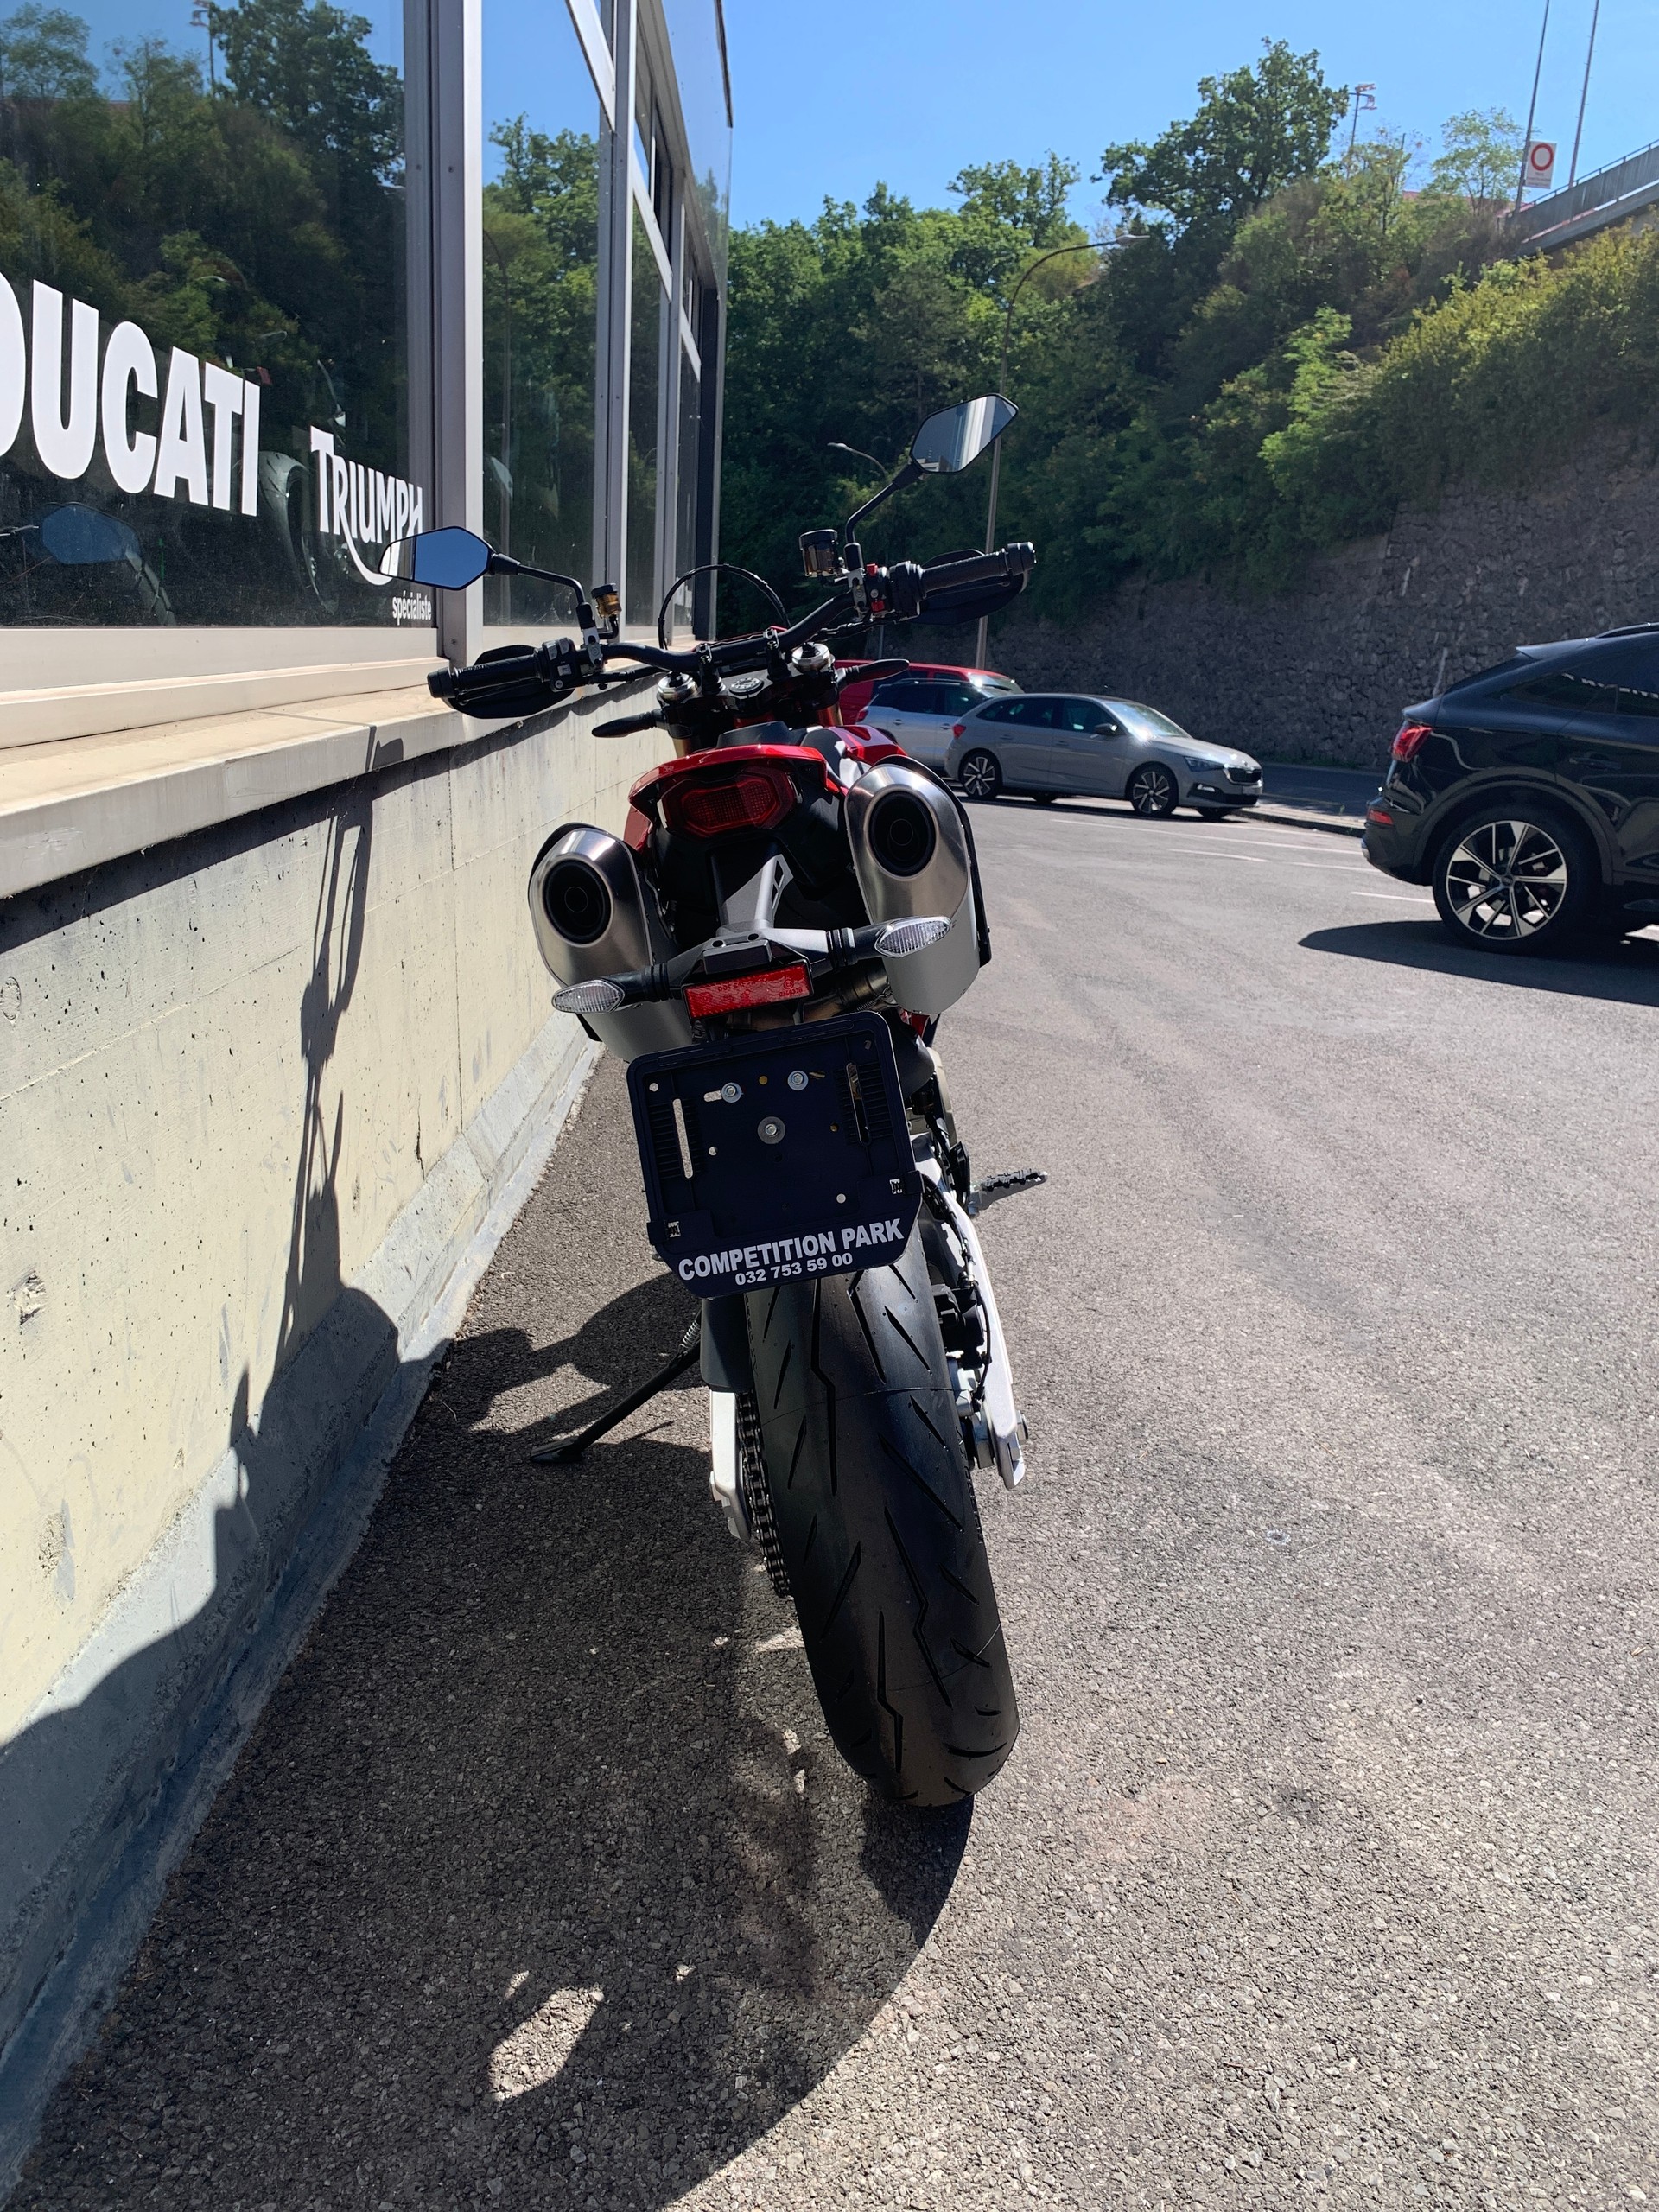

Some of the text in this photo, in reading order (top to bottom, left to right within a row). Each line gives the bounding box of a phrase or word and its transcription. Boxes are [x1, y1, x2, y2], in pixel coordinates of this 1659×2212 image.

[310, 425, 423, 585] TRIUMPH
[392, 590, 432, 626] spécialiste
[678, 1217, 905, 1281] COMPETITION PARK
[735, 1252, 854, 1286] 032 753 59 00
